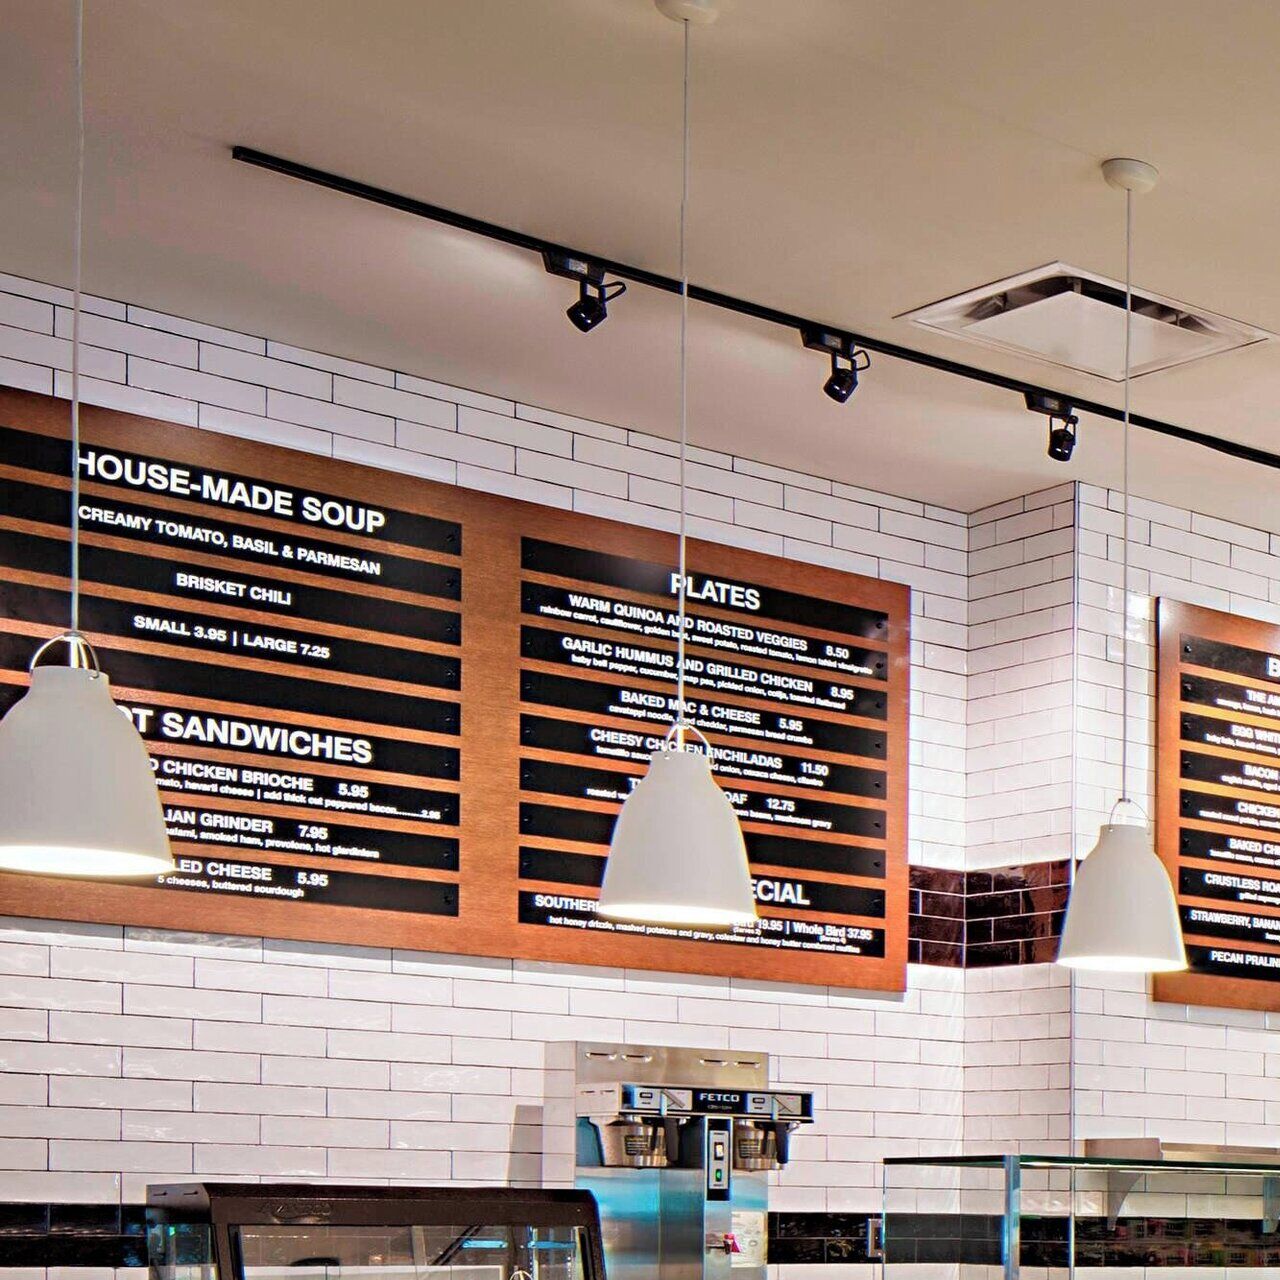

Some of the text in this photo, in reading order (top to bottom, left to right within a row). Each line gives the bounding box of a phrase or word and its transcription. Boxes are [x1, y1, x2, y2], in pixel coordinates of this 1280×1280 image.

[77, 450, 386, 534] HOUSE-MADE SOUP
[78, 505, 380, 576] CREAMY TOMATO, BASIL & PARMESAN
[176, 573, 292, 606] BRISKET CHILI
[670, 573, 761, 610] PLATES
[134, 616, 330, 659] SMALL 3.95 LARGE 7.25
[568, 594, 611, 613] WARM
[613, 604, 664, 624] QUINOA
[697, 620, 754, 640] ROASTED
[756, 631, 808, 652] VEGGIES
[825, 646, 850, 660] 8.50
[562, 636, 613, 656] GARLIC
[615, 646, 674, 668] HUMMUS
[706, 662, 758, 682] GRILLED
[760, 674, 813, 693] CHICKEN
[830, 686, 854, 700] 8.95
[621, 691, 665, 708] BAKED
[700, 705, 709, 717] &
[711, 706, 761, 724] CHEESE
[778, 718, 803, 732] 5.95
[162, 712, 372, 764] SANDWICHES
[590, 729, 643, 750] CHEESY
[800, 761, 829, 776] 11.50
[163, 760, 369, 799] CHICKEN BRIOCHE 5.95
[766, 797, 795, 812] 12.75
[200, 812, 328, 840] GRINDER 7.95
[1229, 838, 1262, 852] BAKED
[206, 862, 328, 887] CHEESE 5.95
[1205, 874, 1260, 891] CRUSTLESS
[758, 919, 872, 941] 19.95 Whole Bird 37.95
[1191, 909, 1251, 929] STRAWBERRY,
[1211, 951, 1243, 964] PECAN
[700, 1092, 740, 1103] FETCO
